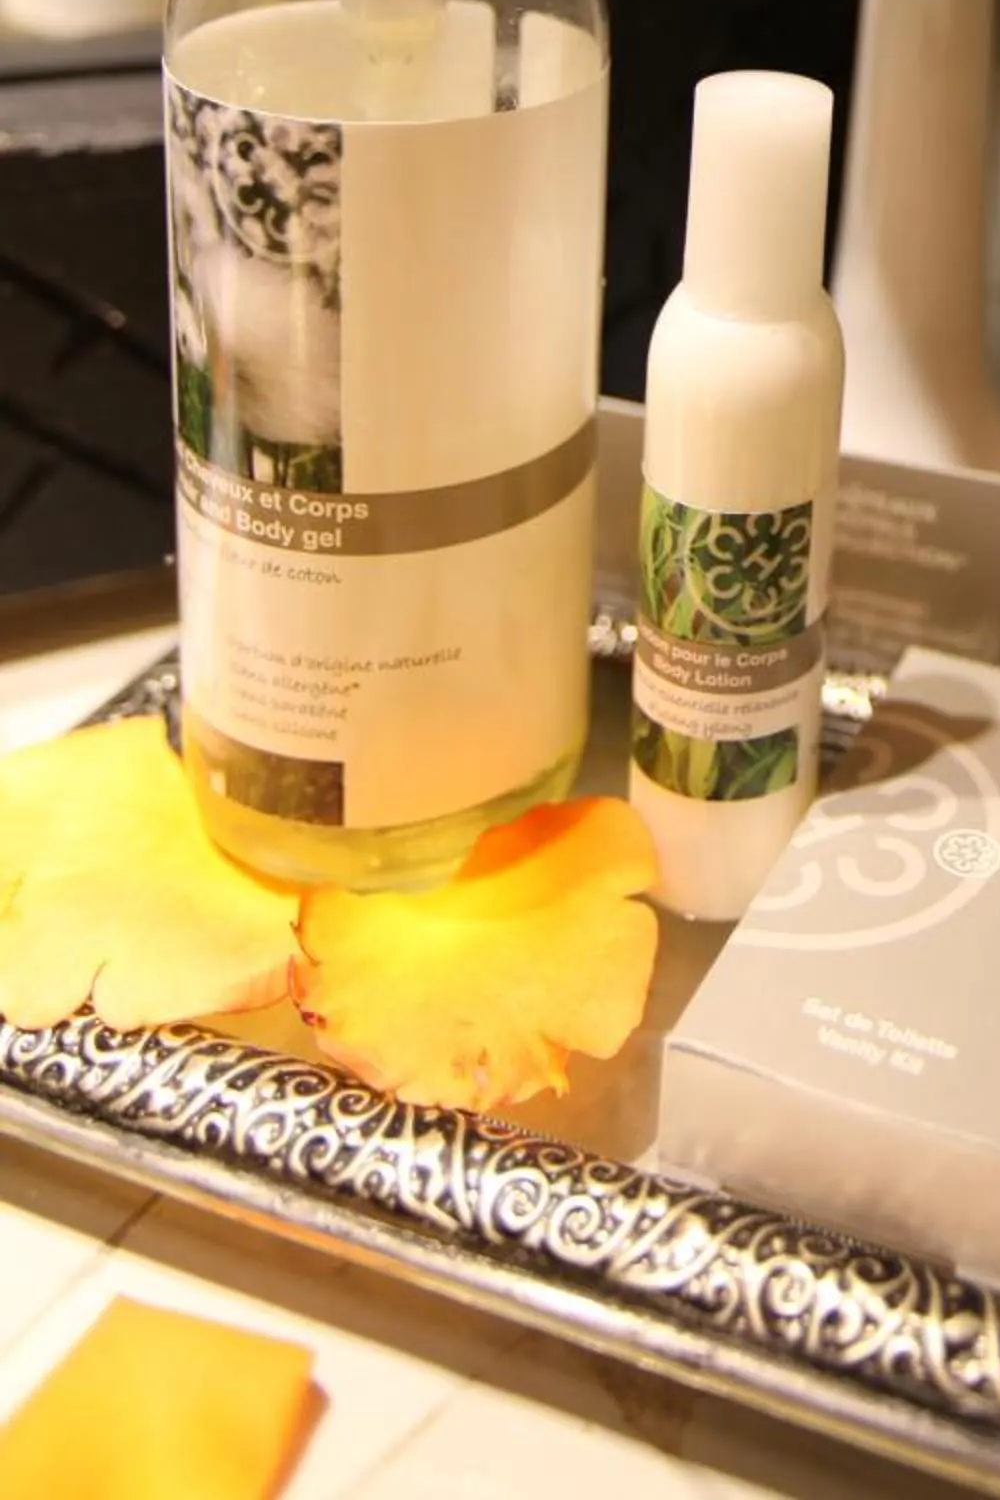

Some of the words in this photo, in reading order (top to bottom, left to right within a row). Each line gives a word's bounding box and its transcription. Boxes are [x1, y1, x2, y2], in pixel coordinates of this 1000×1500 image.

[258, 491, 282, 512] et
[288, 494, 369, 523] Corps
[236, 509, 295, 546] Body
[302, 528, 342, 551] gel
[671, 646, 711, 668] pour
[714, 653, 732, 668] le
[736, 647, 789, 669] Corps
[694, 670, 752, 688] Lotion
